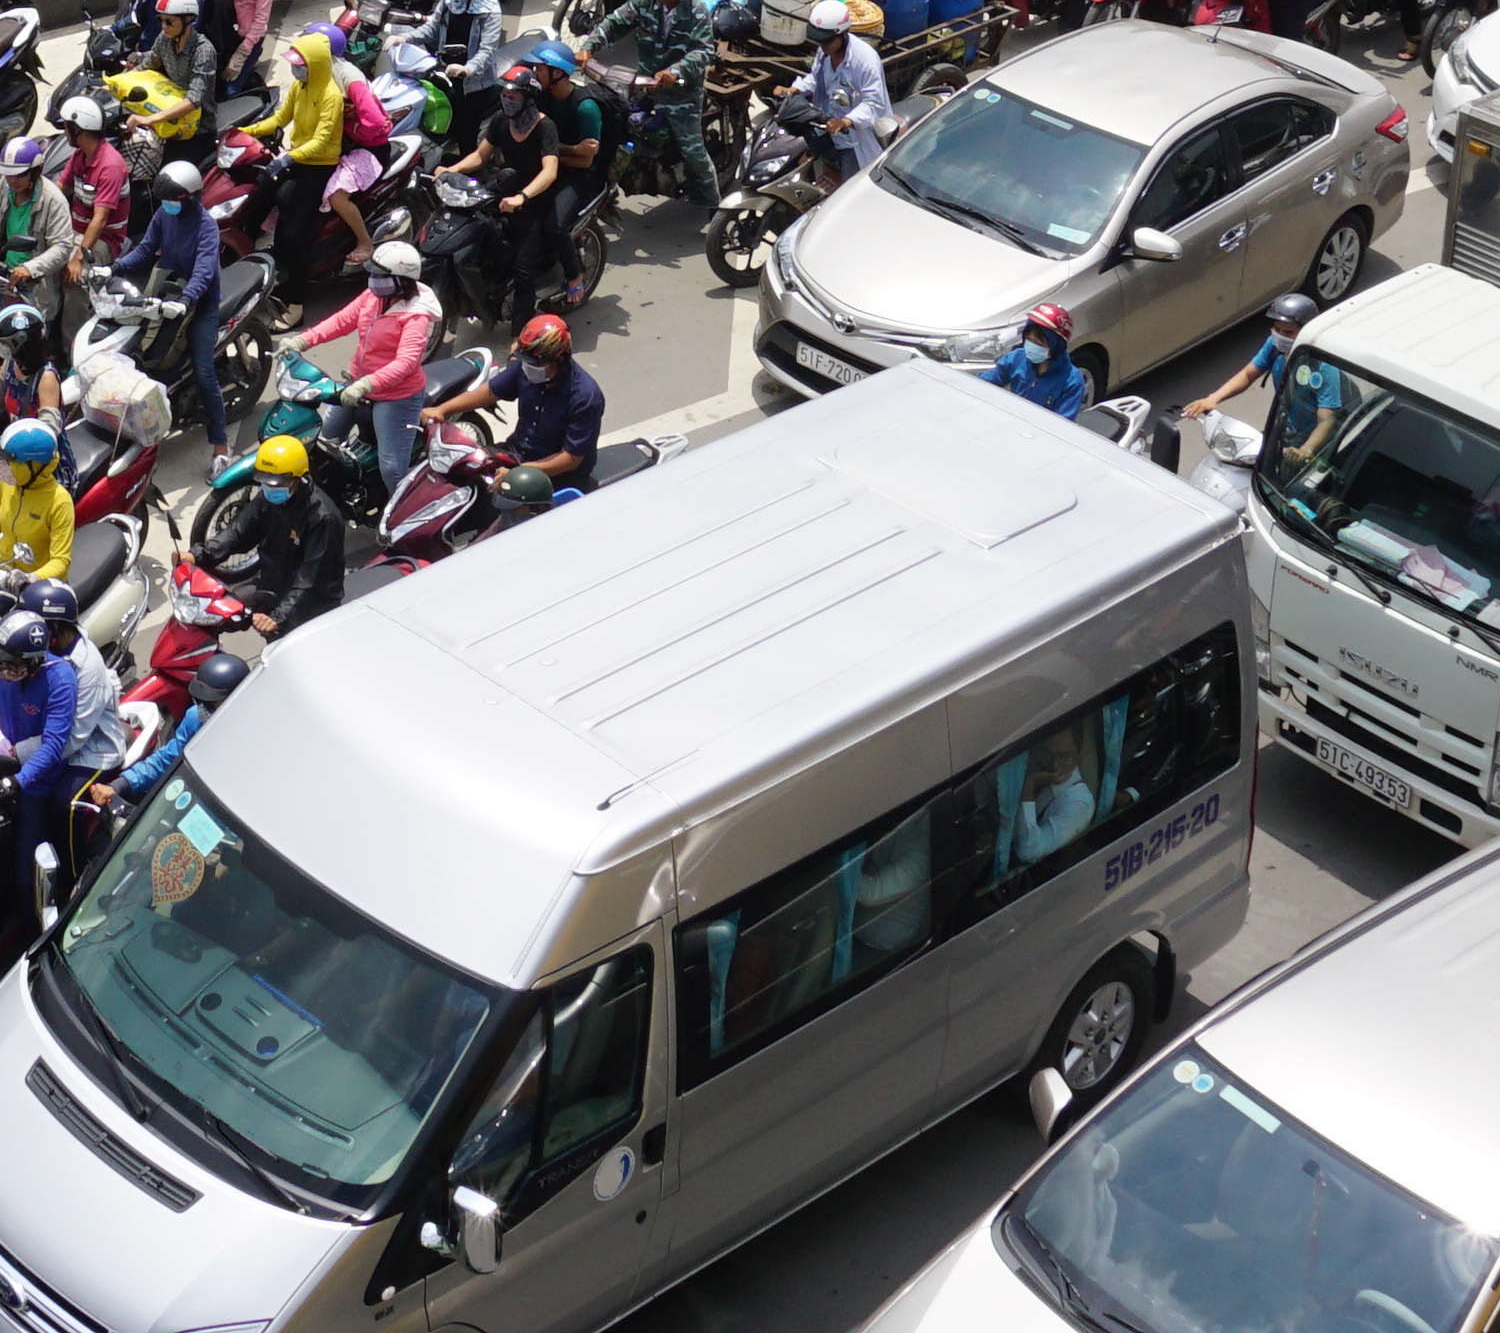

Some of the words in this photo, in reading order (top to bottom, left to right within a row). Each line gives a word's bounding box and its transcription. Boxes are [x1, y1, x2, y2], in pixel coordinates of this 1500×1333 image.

[1339, 645, 1419, 700] ISUZU
[1456, 655, 1498, 682] NMR
[1319, 740, 1408, 803] 51C-493.53
